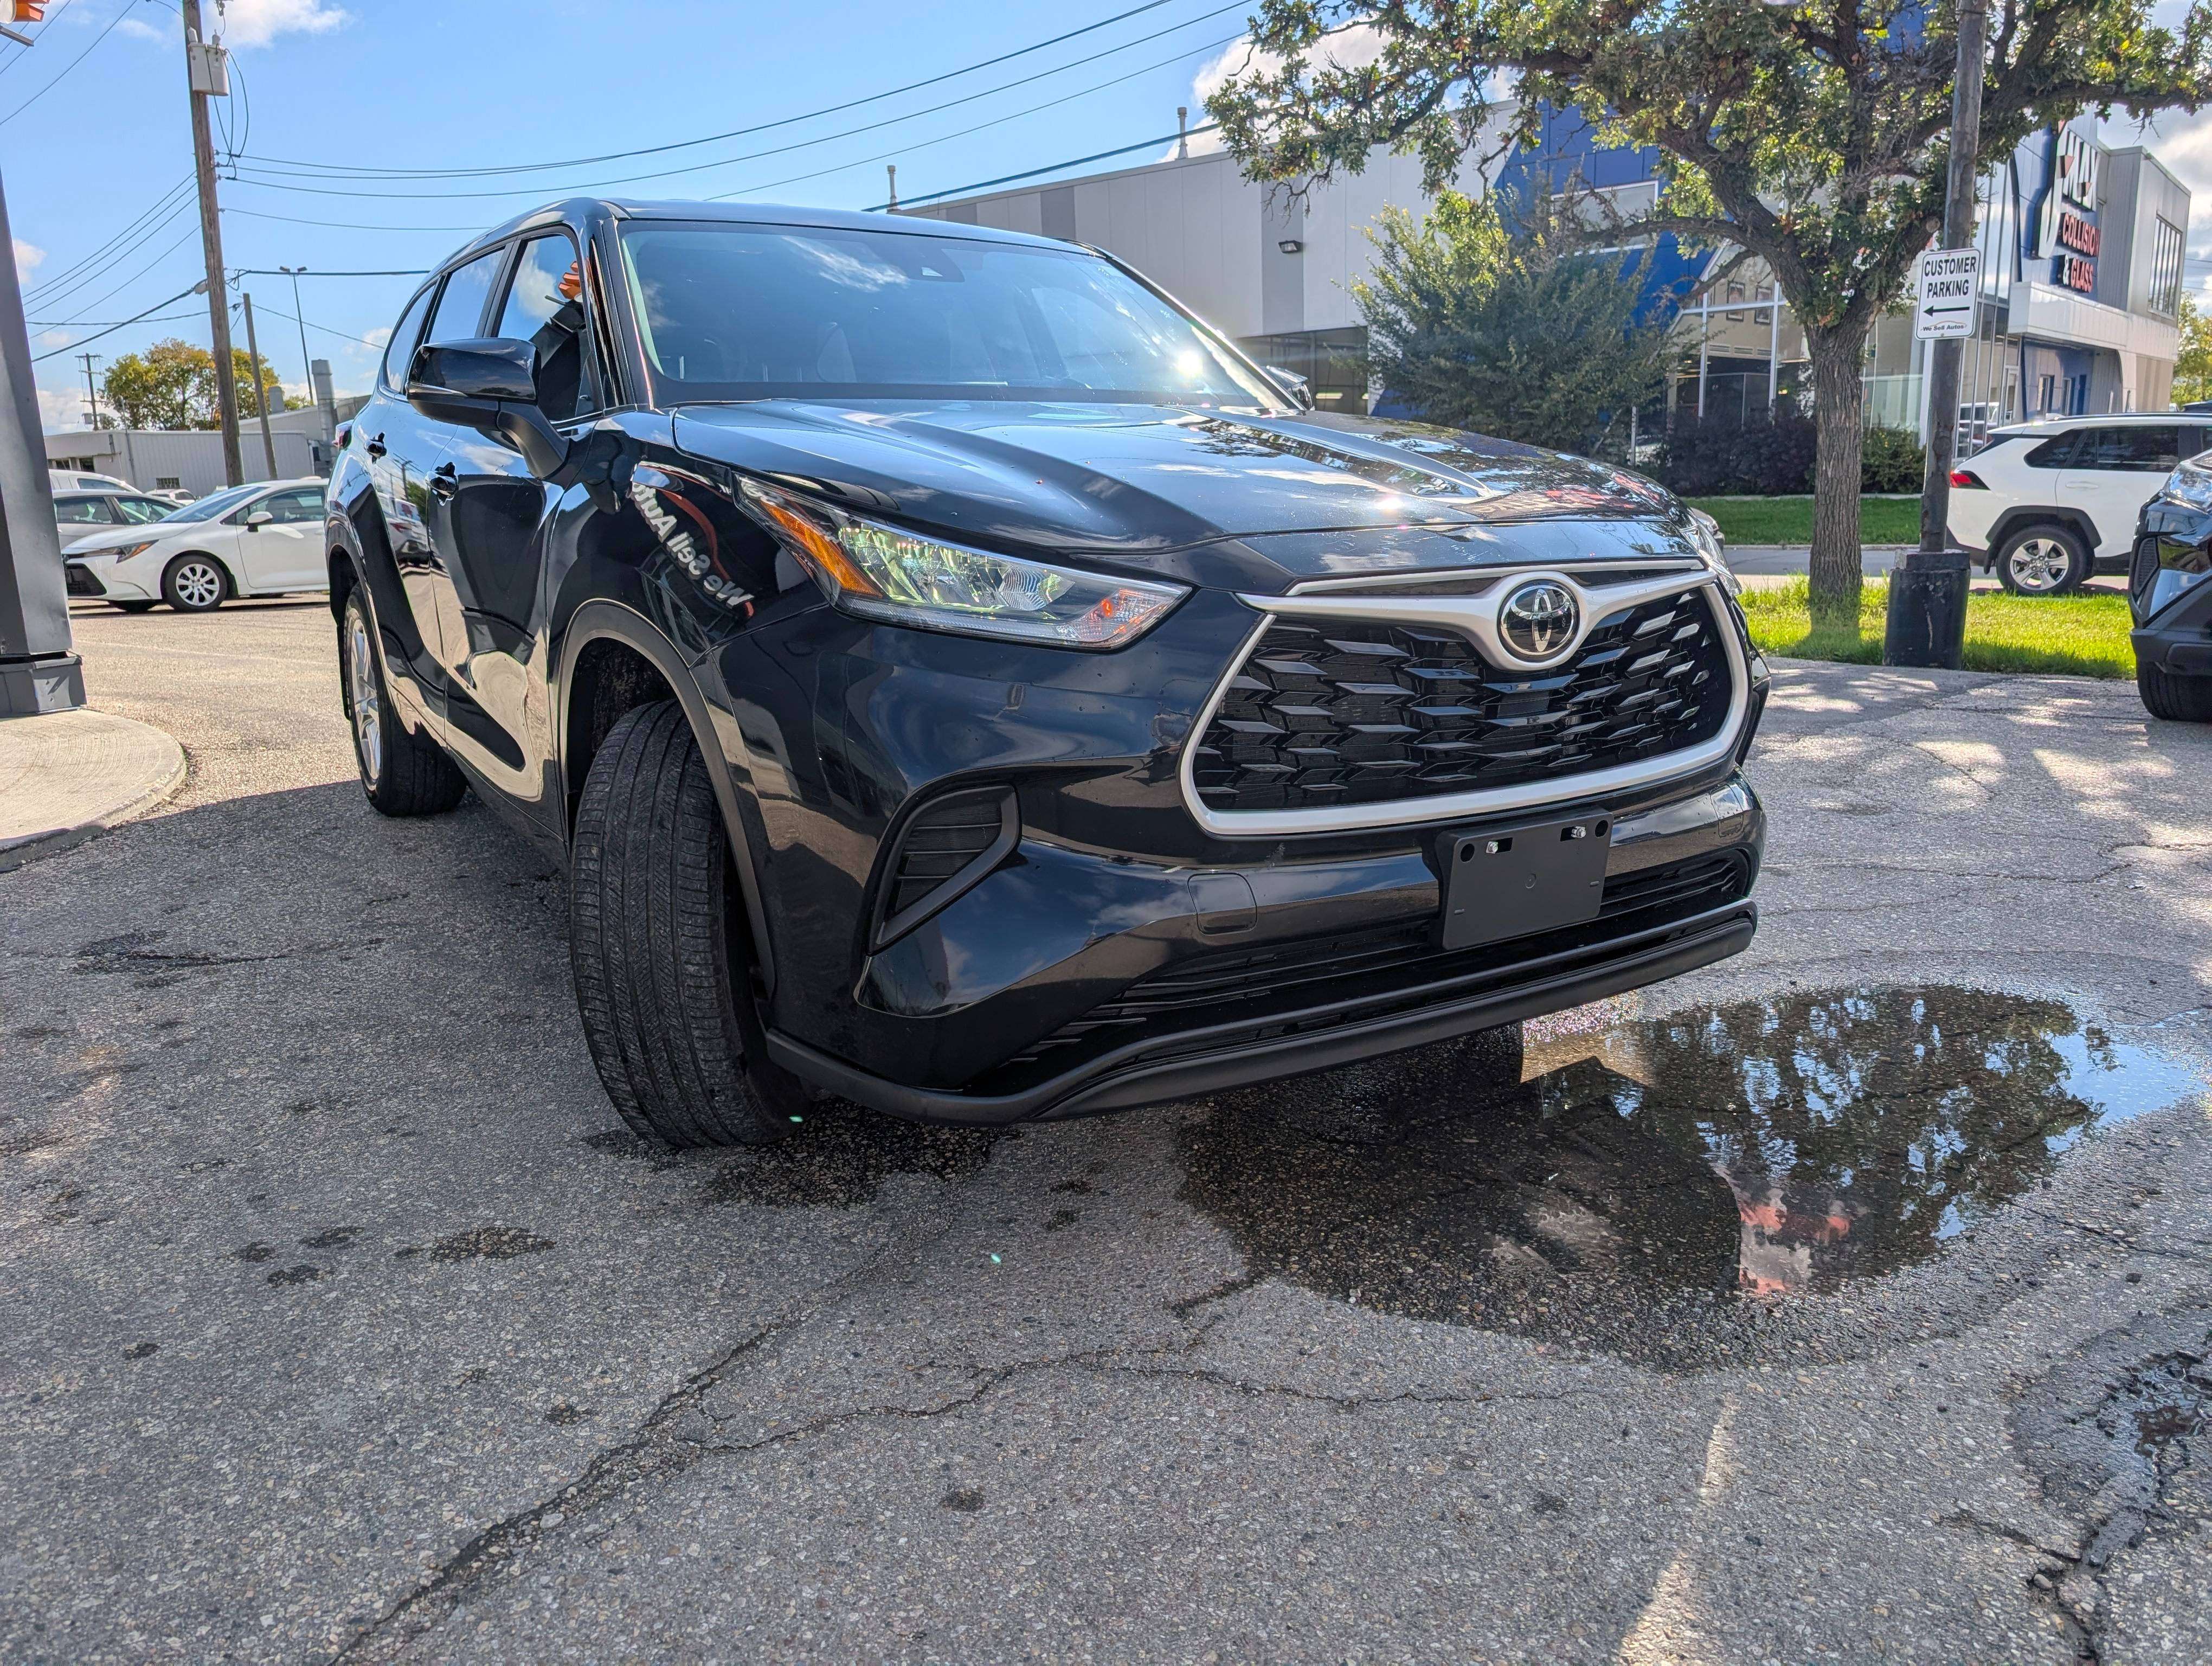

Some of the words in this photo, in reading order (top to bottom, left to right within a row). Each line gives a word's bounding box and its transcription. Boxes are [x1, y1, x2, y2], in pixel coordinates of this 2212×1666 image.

[2062, 212, 2100, 256] COLLISION
[1925, 256, 1977, 277] CUSTOMER
[2070, 258, 2093, 293] GLASS
[1927, 279, 1969, 299] PARKING
